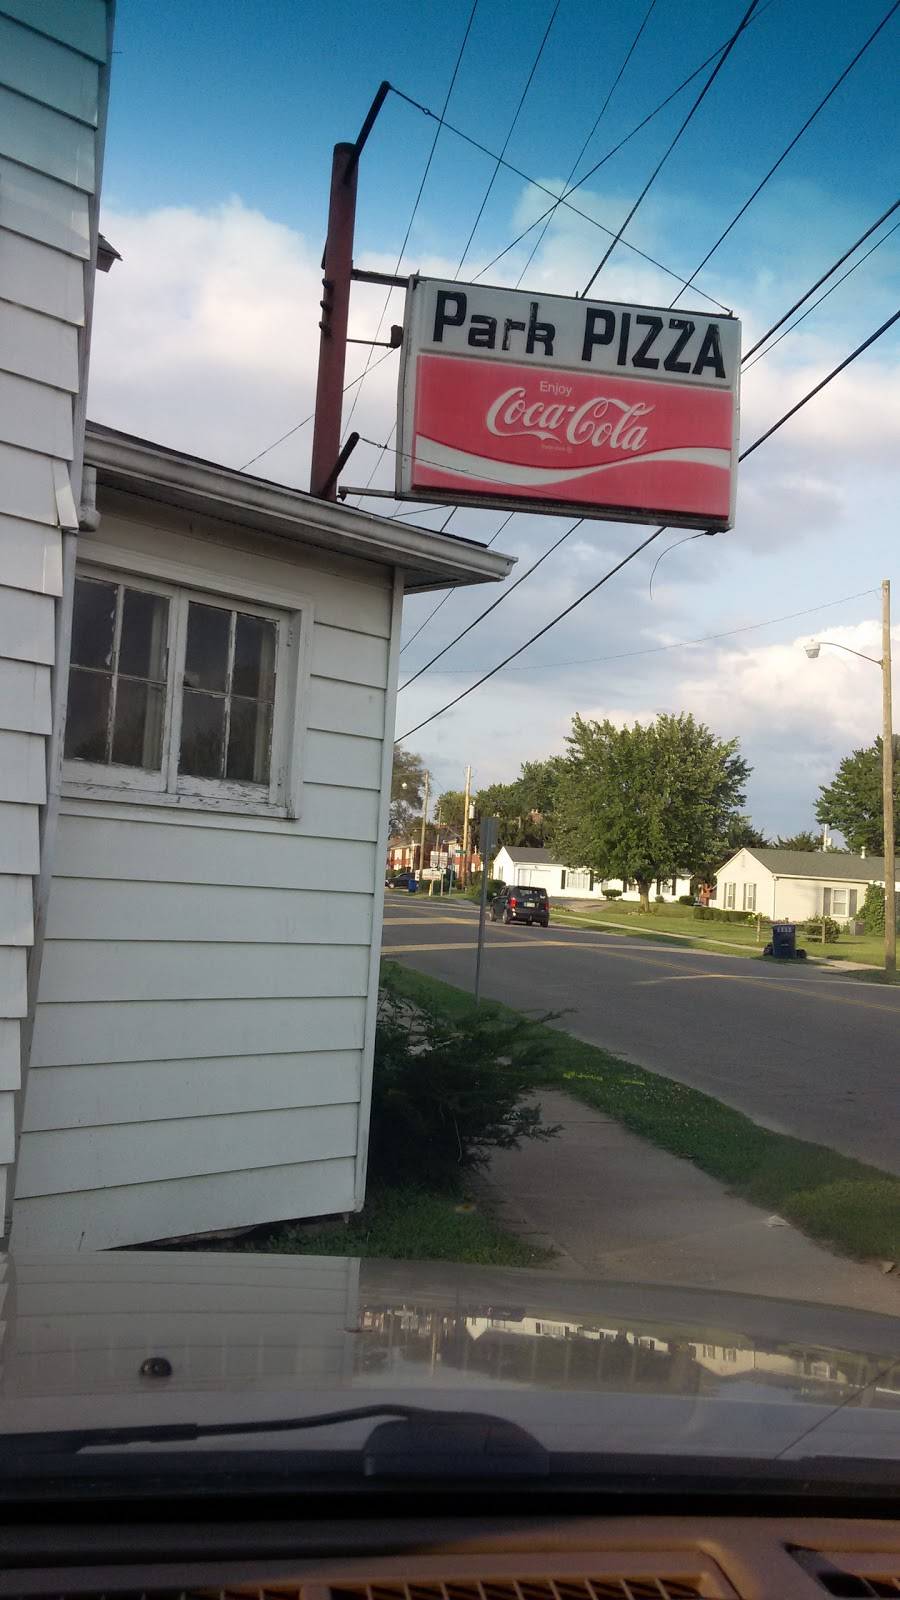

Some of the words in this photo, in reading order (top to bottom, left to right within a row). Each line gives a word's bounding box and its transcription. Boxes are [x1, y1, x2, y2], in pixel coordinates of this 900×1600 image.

[432, 290, 556, 356] Park
[581, 307, 726, 379] PIZZA
[486, 387, 656, 451] Coca-Cola
[539, 380, 573, 397] Enjoy
